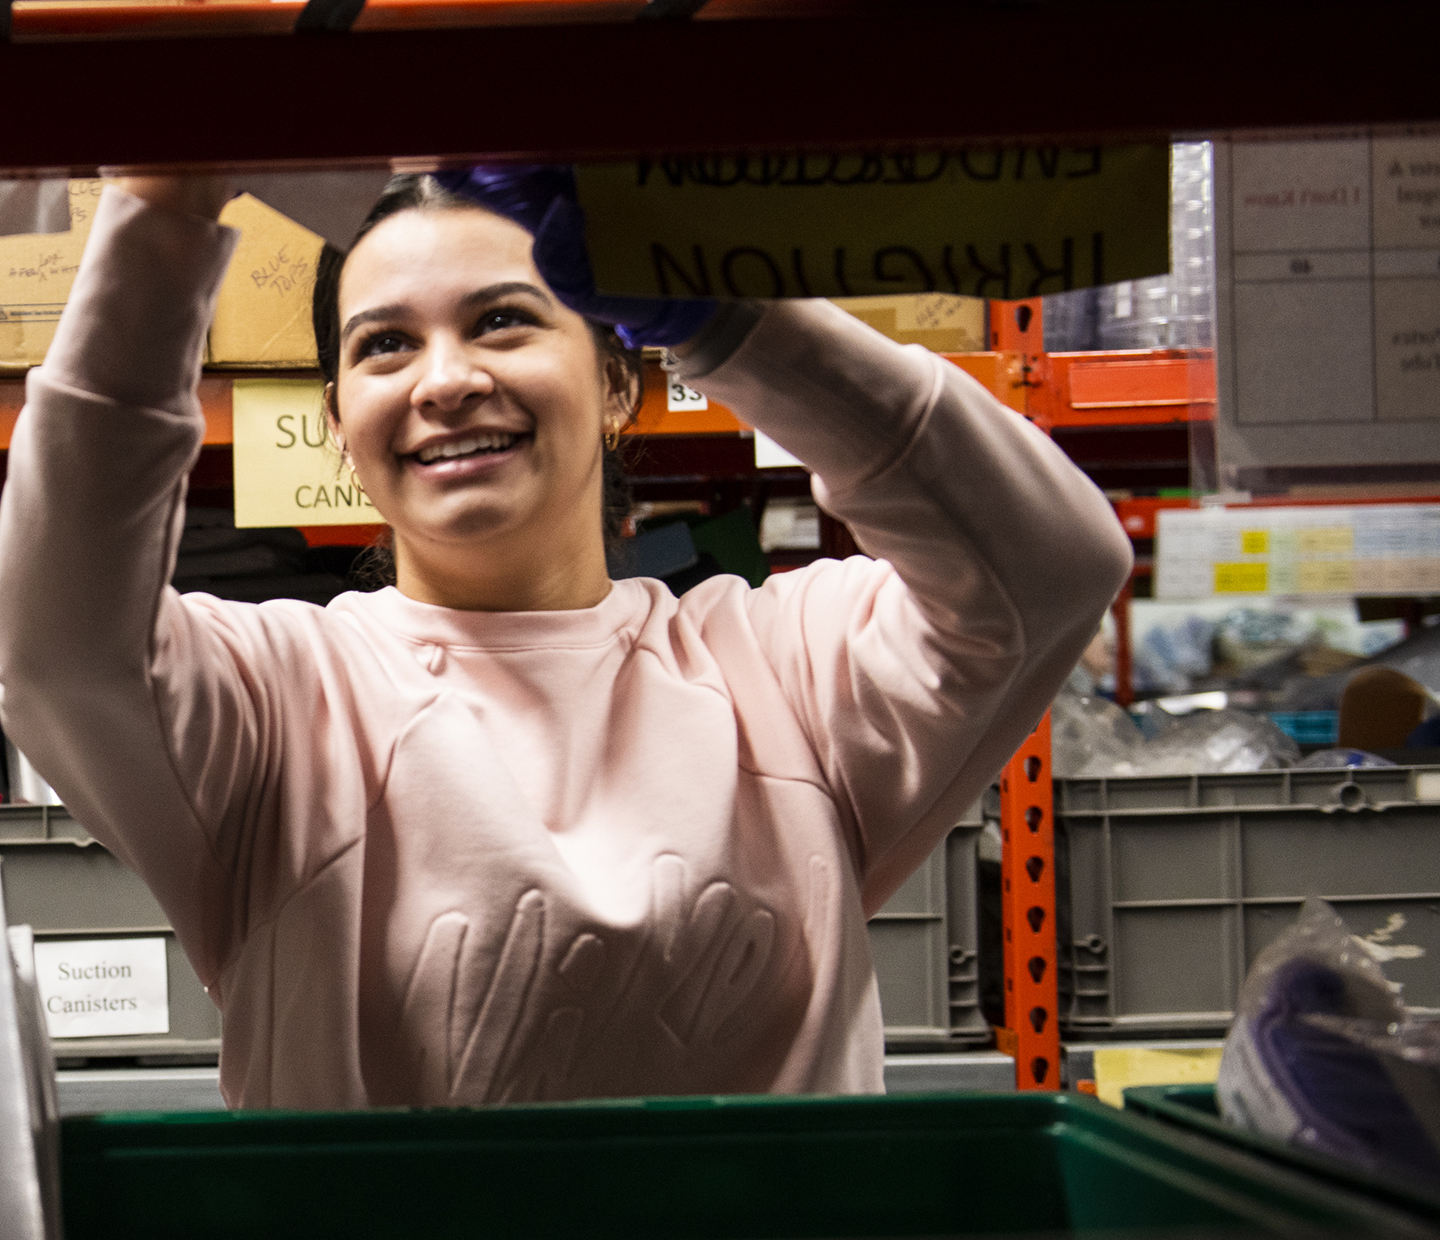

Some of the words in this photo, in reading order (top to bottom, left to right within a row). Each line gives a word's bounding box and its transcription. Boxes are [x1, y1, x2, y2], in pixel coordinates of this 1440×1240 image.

[251, 244, 290, 289] BLUE
[269, 257, 308, 297] TOPS
[276, 414, 328, 449] SU
[58, 961, 133, 981] Suction
[46, 994, 138, 1014] Canisters
